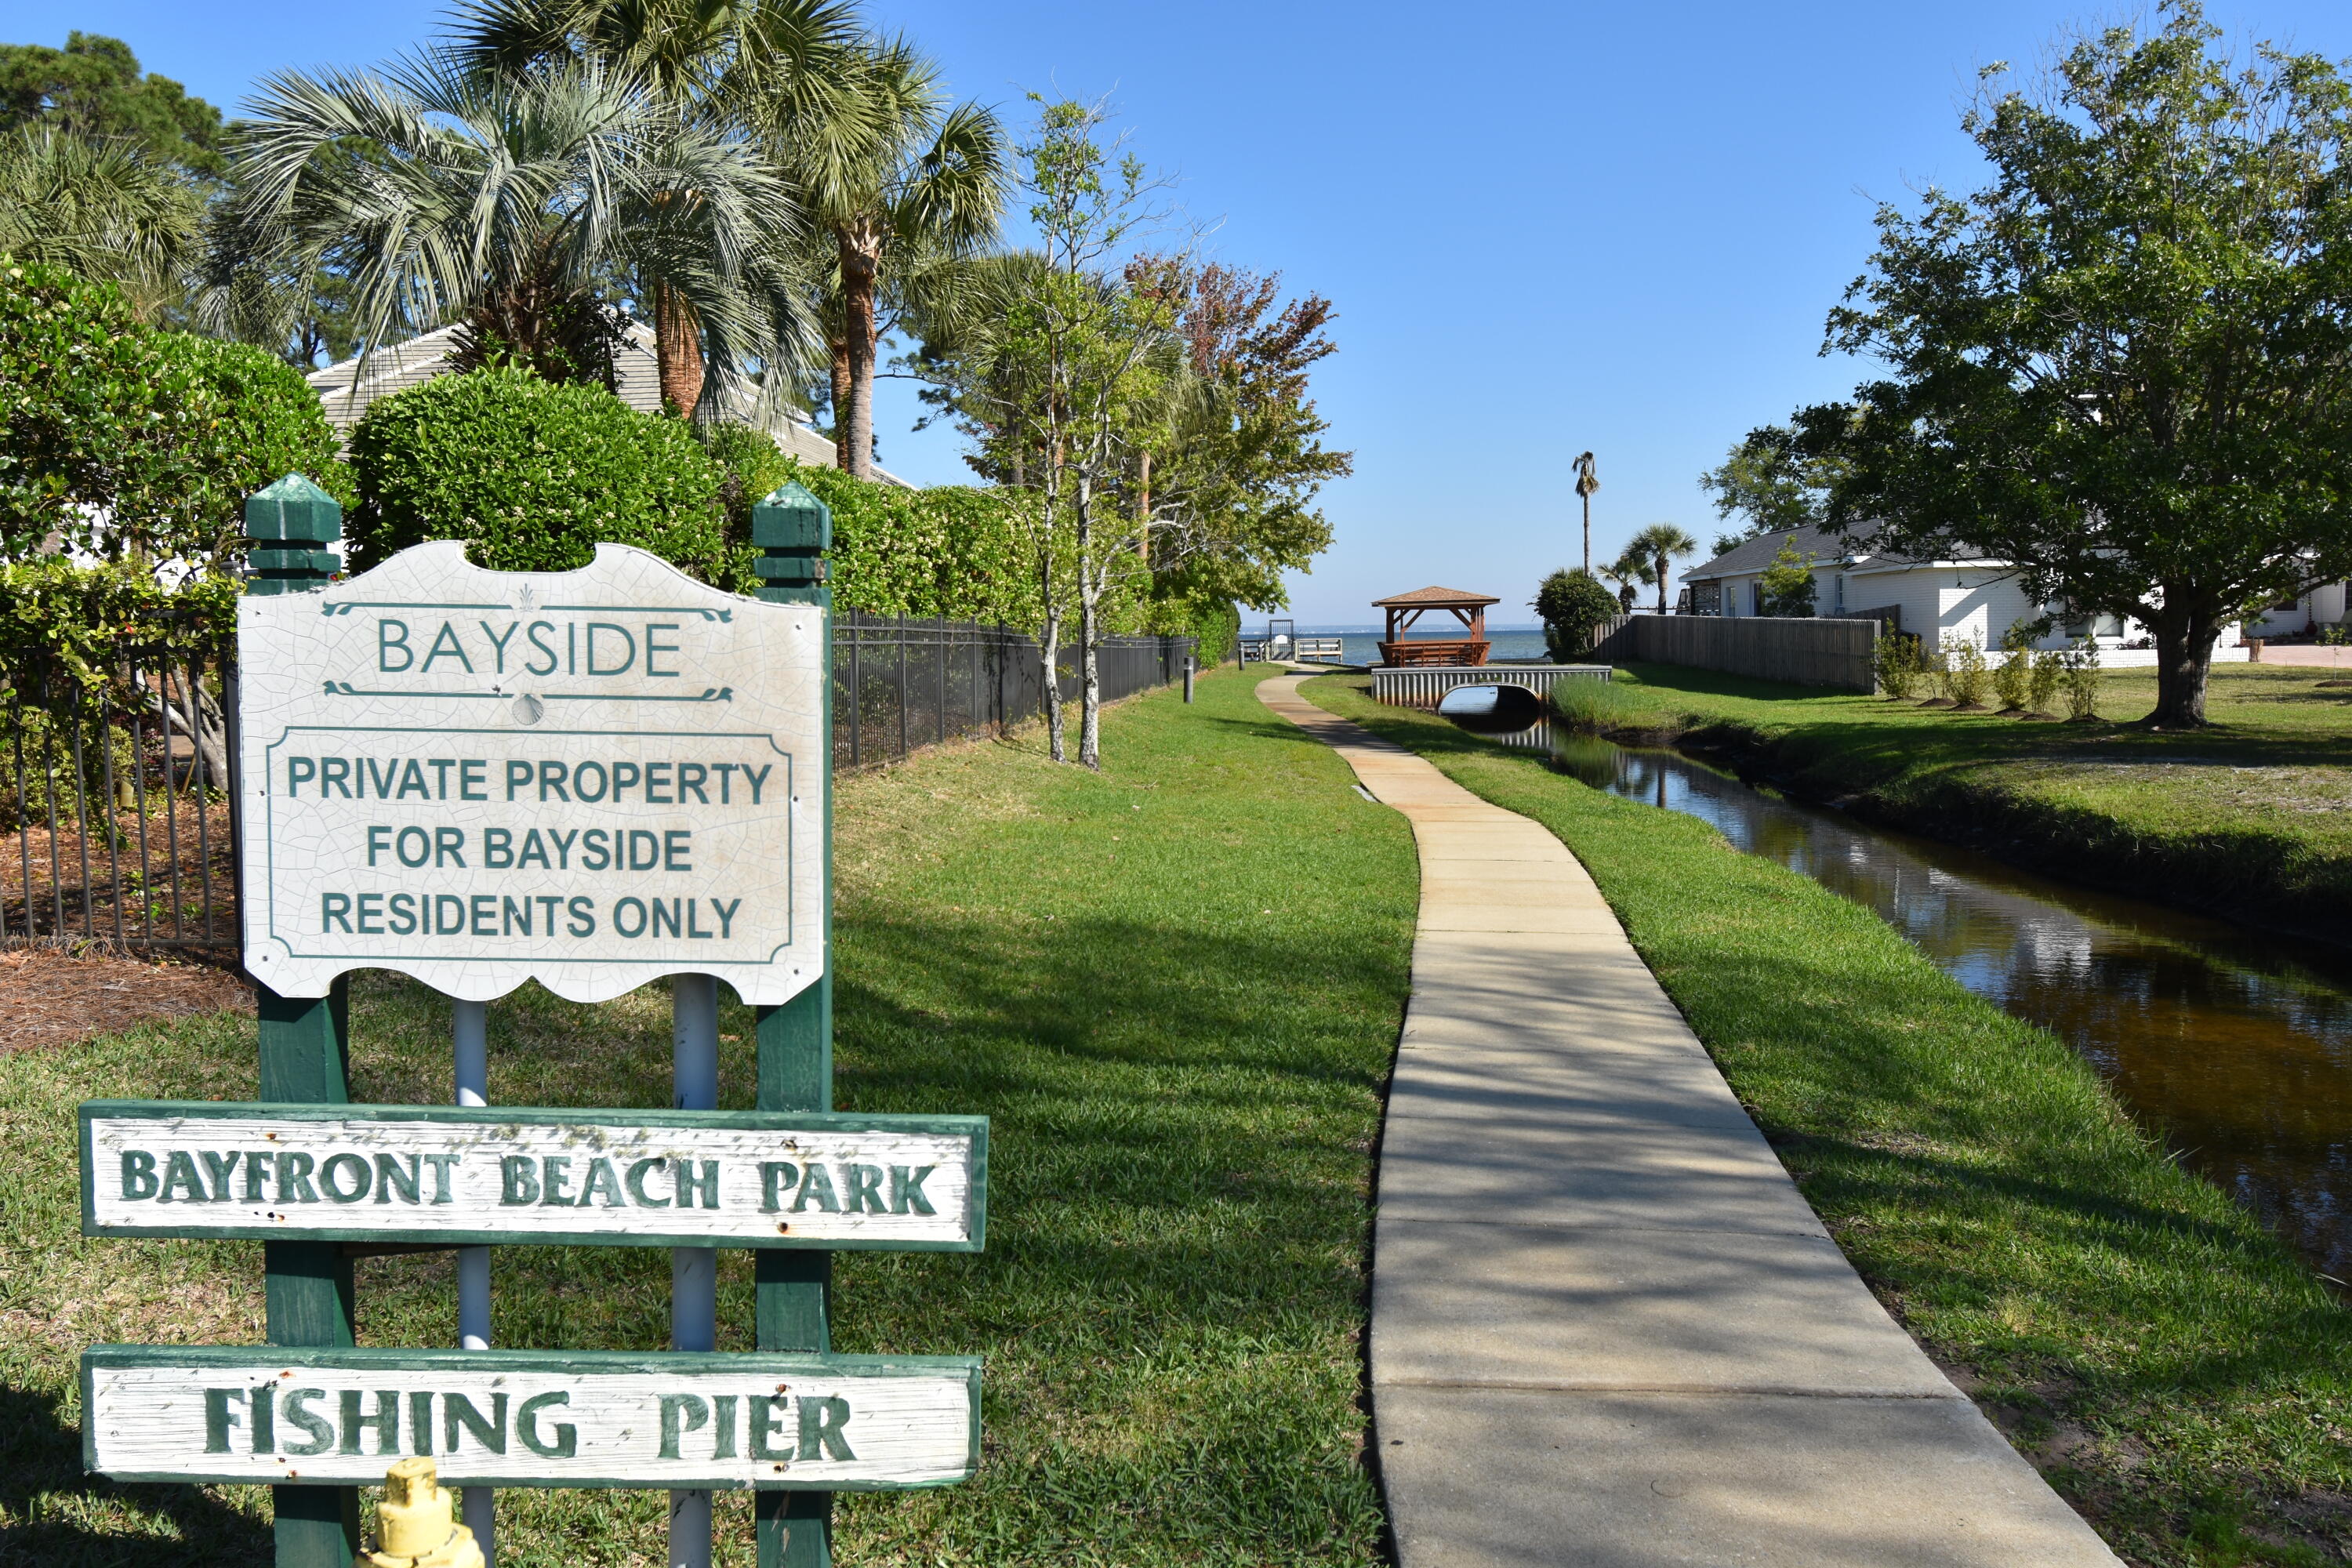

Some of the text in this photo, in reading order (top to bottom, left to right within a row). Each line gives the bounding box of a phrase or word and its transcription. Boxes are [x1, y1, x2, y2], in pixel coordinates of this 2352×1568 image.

[378, 619, 681, 677] BAYSIDE
[289, 757, 773, 805] PRIVATE PROPERTY
[367, 826, 692, 872] FOR BAYSIDE
[322, 893, 742, 939] RESIDENTS ONLY
[121, 1150, 937, 1215] BAYFRONT BEACH PARK
[205, 1388, 857, 1461] FISHING PIER
